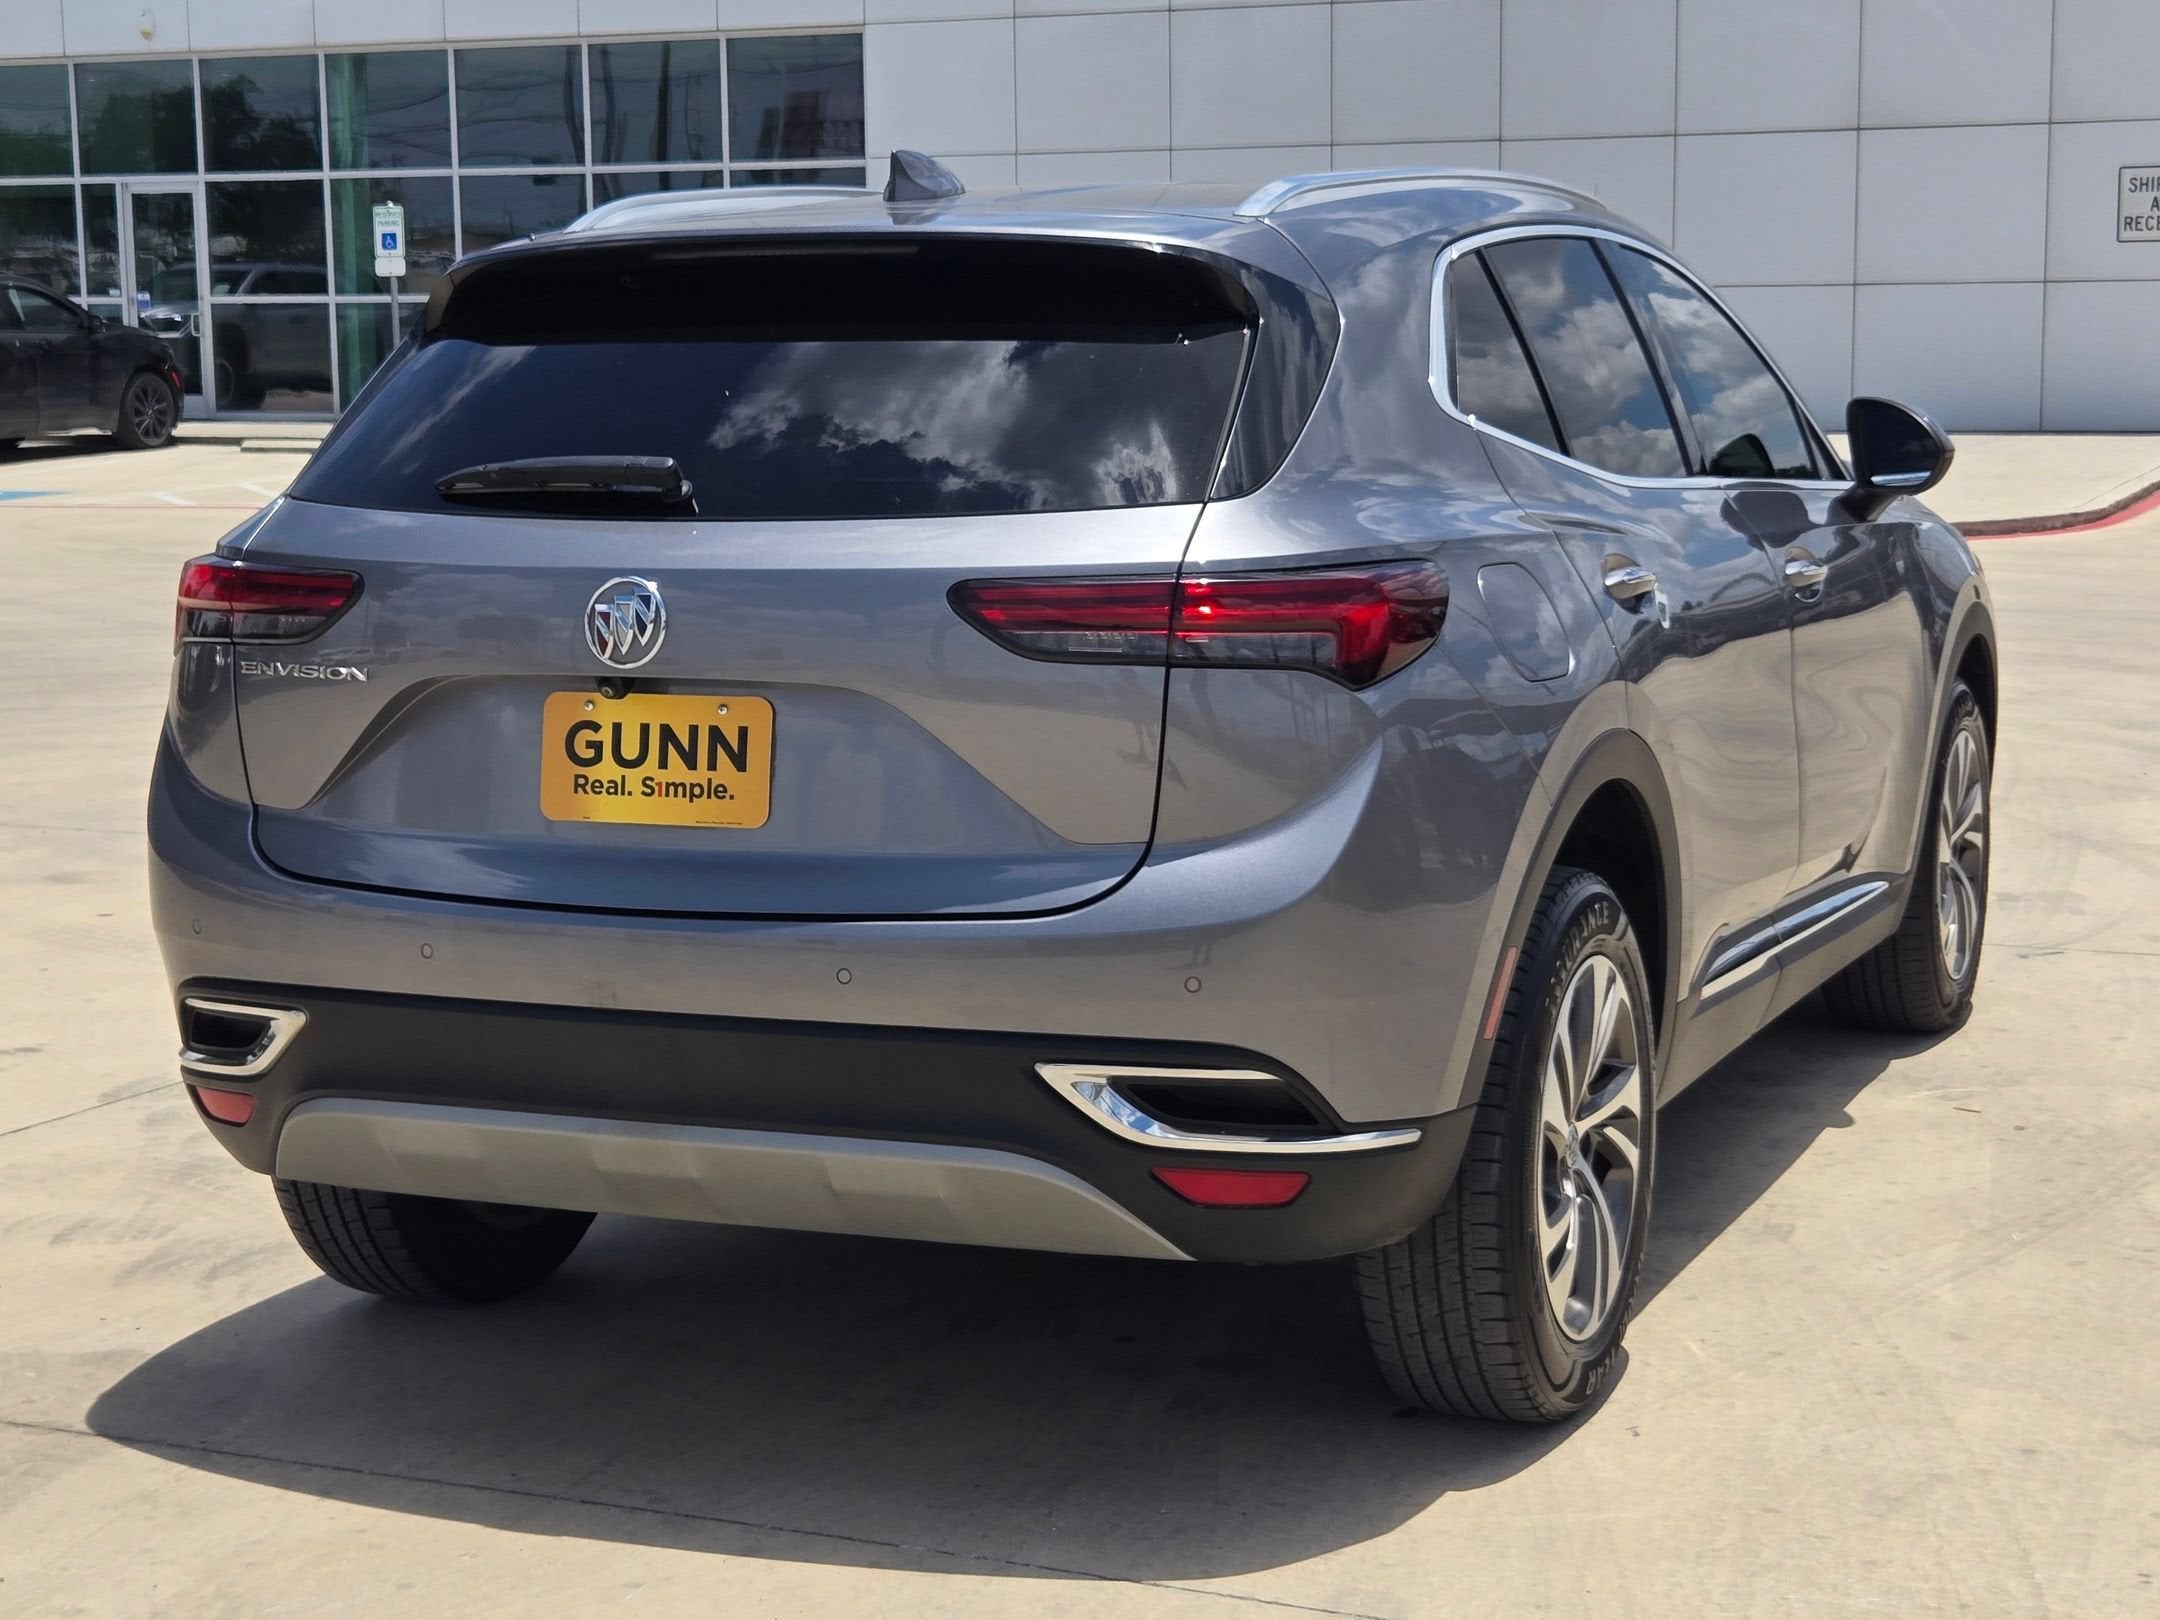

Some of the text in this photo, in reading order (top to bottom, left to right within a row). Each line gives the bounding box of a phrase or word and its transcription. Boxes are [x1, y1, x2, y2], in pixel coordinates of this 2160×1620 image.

[240, 660, 368, 682] ENVISION
[565, 719, 749, 773] GUNN
[573, 774, 632, 797] Real.
